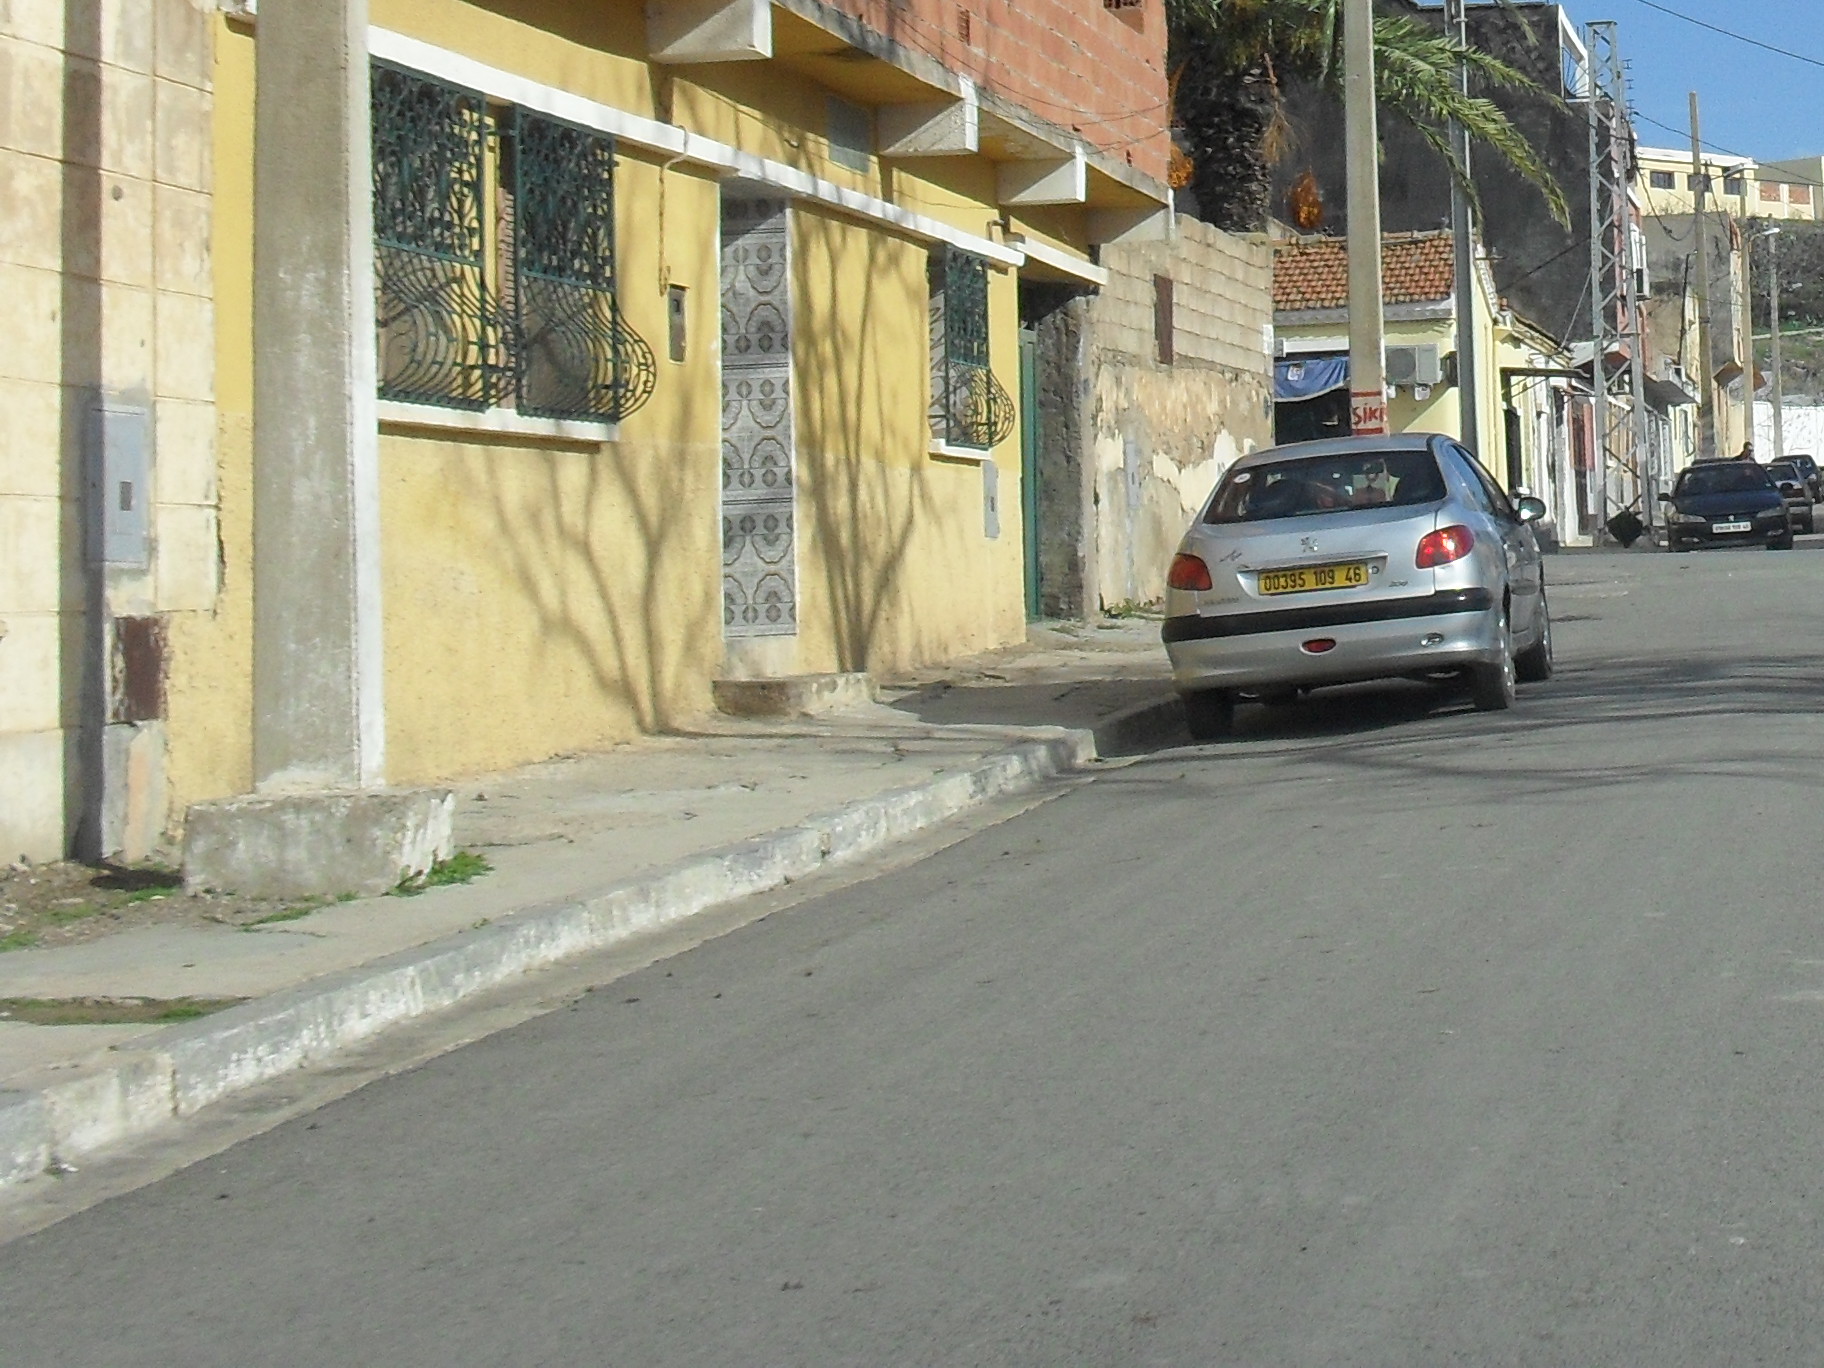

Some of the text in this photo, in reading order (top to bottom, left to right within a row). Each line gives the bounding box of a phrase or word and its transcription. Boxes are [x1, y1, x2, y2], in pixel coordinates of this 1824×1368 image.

[1263, 566, 1362, 592] 00395 109 46
